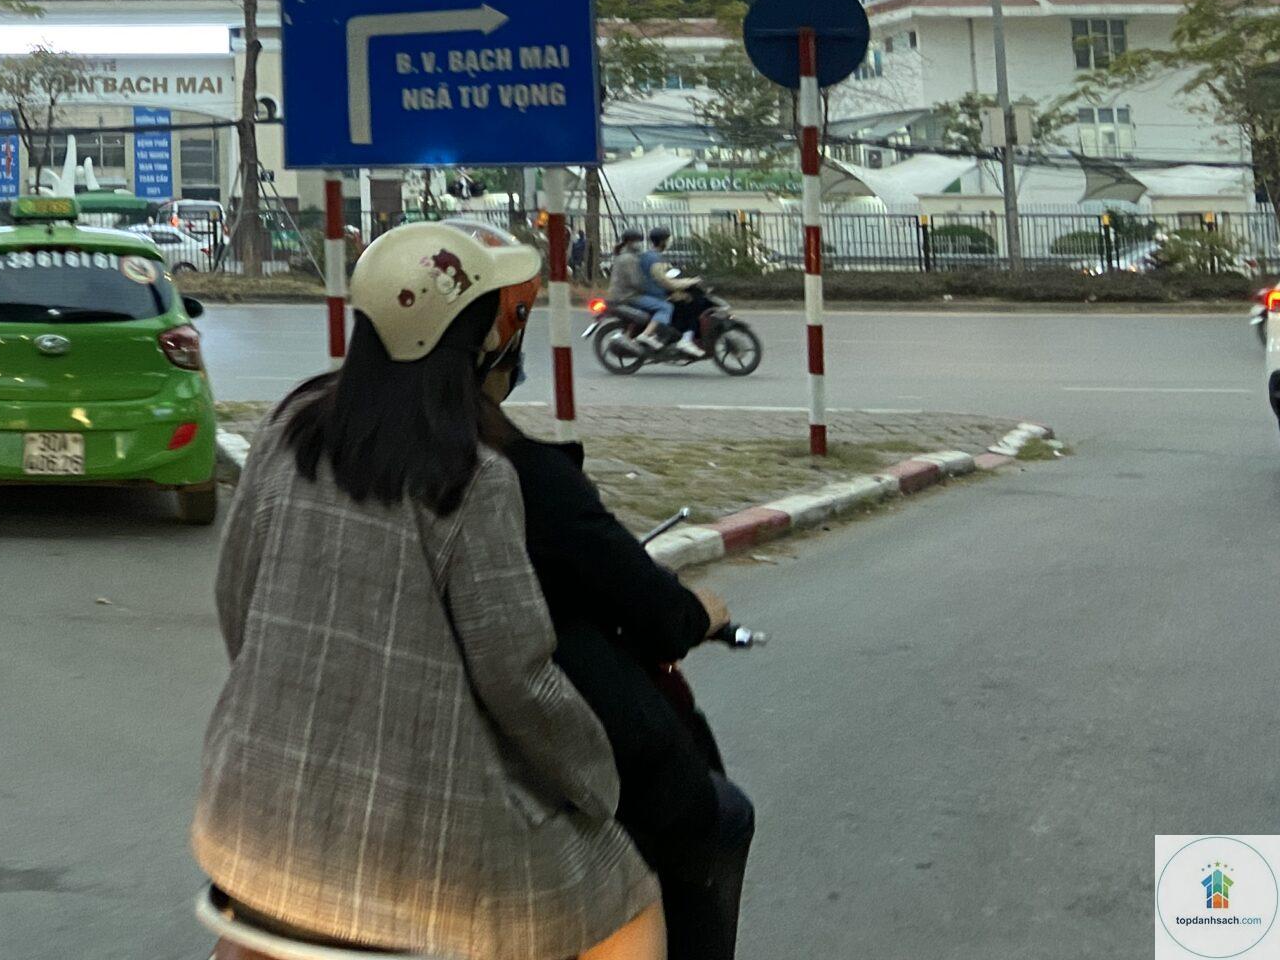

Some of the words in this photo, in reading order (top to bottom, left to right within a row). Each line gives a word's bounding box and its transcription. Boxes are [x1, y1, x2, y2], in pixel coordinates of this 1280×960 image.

[448, 47, 513, 78] BẠCH
[519, 44, 570, 70] MAI
[104, 76, 168, 98] BẠCH
[176, 76, 223, 94] MAI
[401, 81, 453, 111] NGÃ
[458, 82, 492, 109] TƯ
[498, 82, 567, 114] VỌNG
